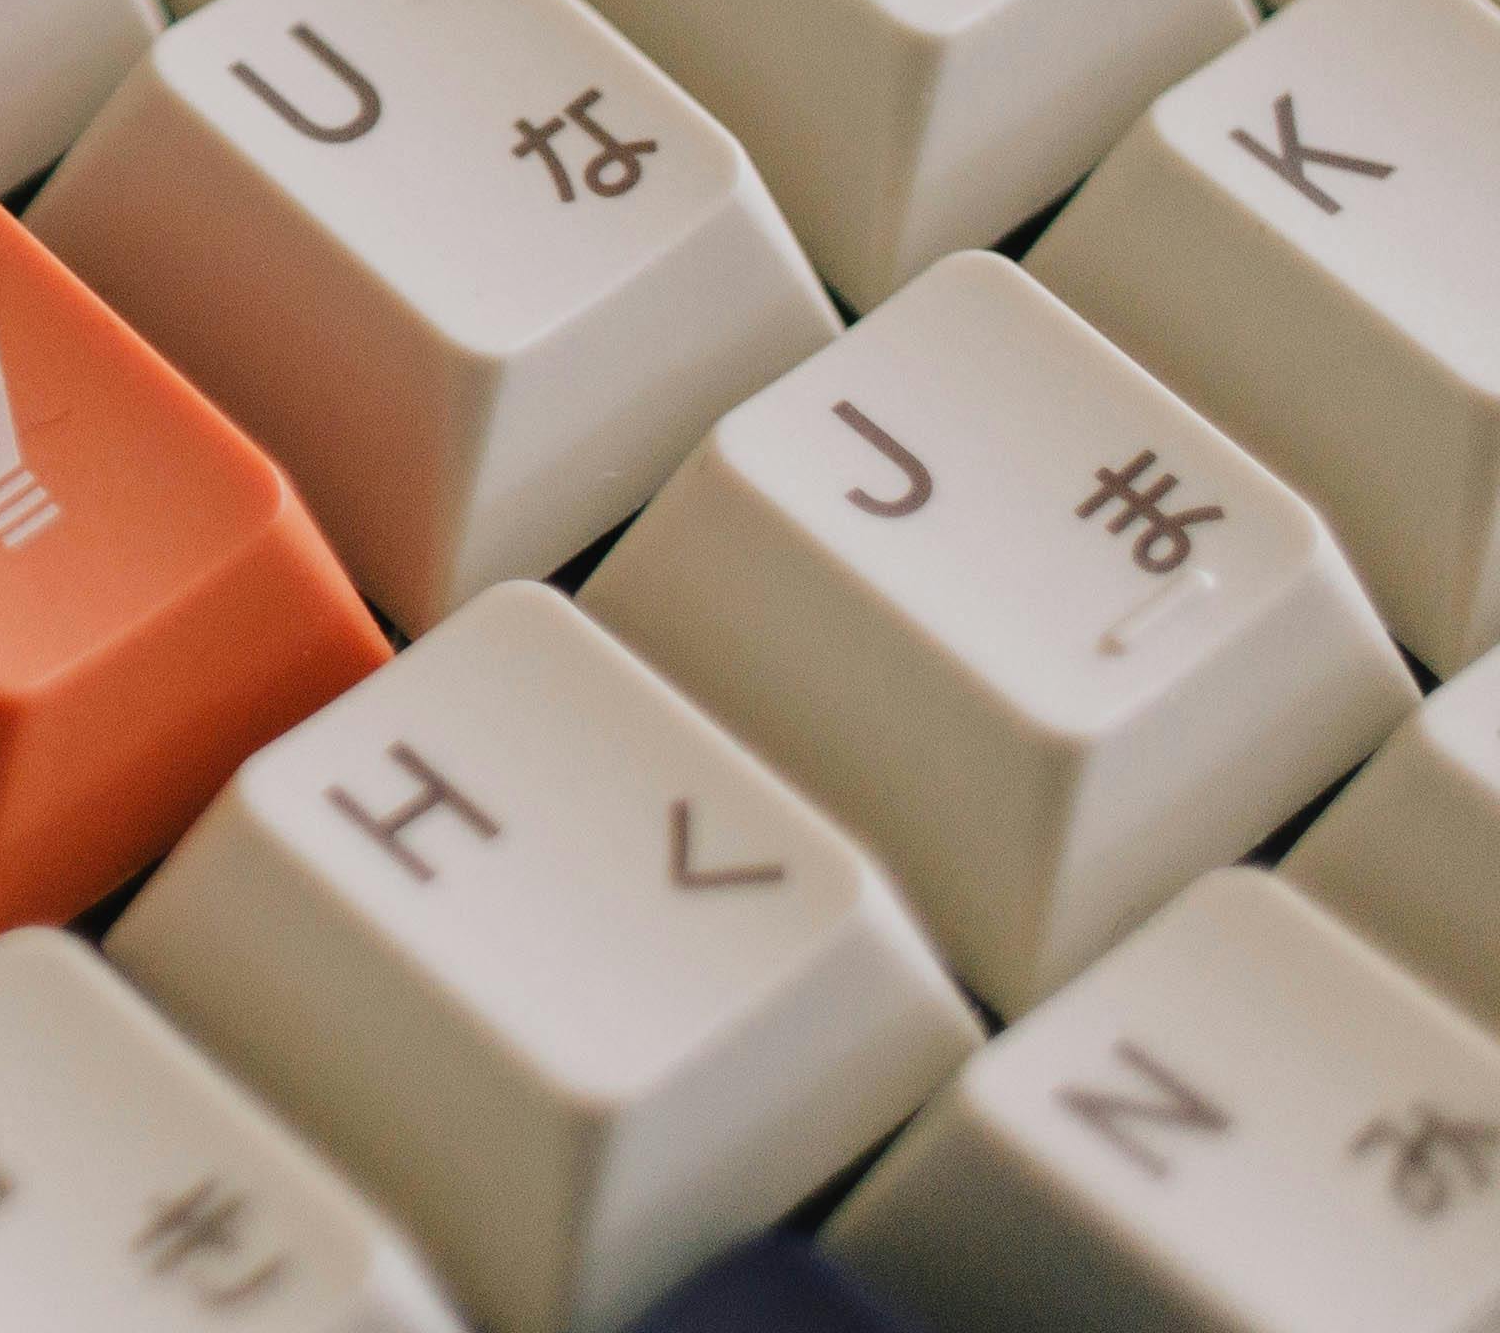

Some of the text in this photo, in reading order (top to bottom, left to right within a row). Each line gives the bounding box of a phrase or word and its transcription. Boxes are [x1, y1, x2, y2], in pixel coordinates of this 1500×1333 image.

[227, 21, 383, 145] U
[510, 86, 659, 205] な
[1228, 91, 1398, 217] K
[831, 398, 934, 519] J
[1074, 448, 1226, 576] ま
[327, 741, 501, 884] H
[1052, 1038, 1232, 1181] N
